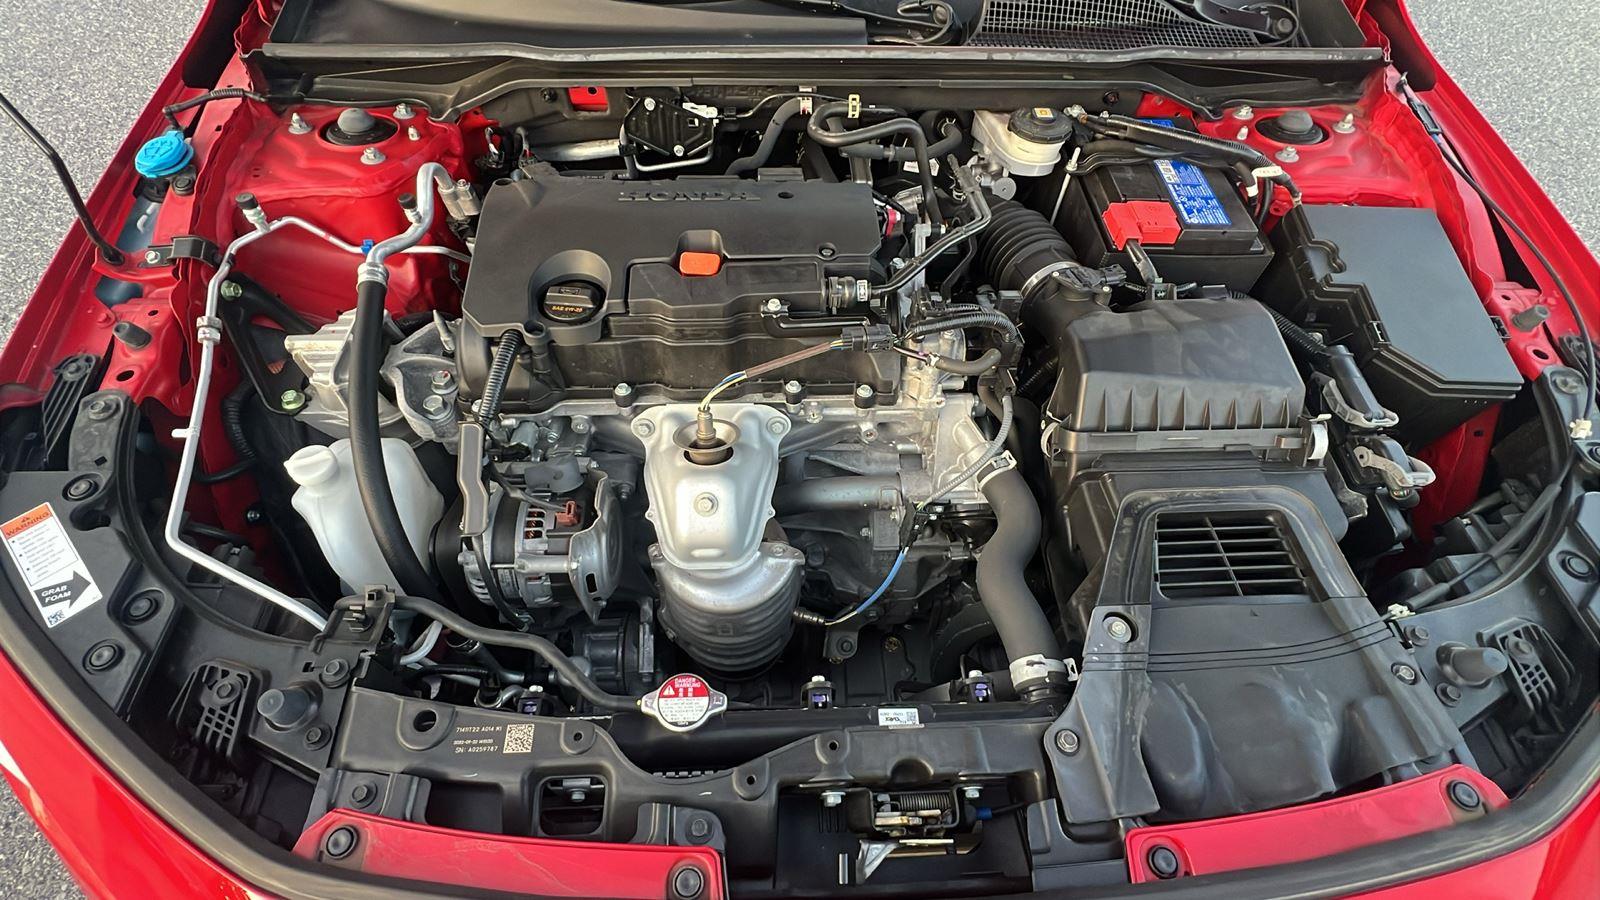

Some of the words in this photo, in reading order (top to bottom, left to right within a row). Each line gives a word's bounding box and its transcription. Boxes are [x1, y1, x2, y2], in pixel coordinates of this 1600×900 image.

[618, 190, 760, 201] HONDA
[5, 511, 49, 536] WARNING
[41, 584, 68, 597] GRAB
[45, 590, 72, 603] FOAM
